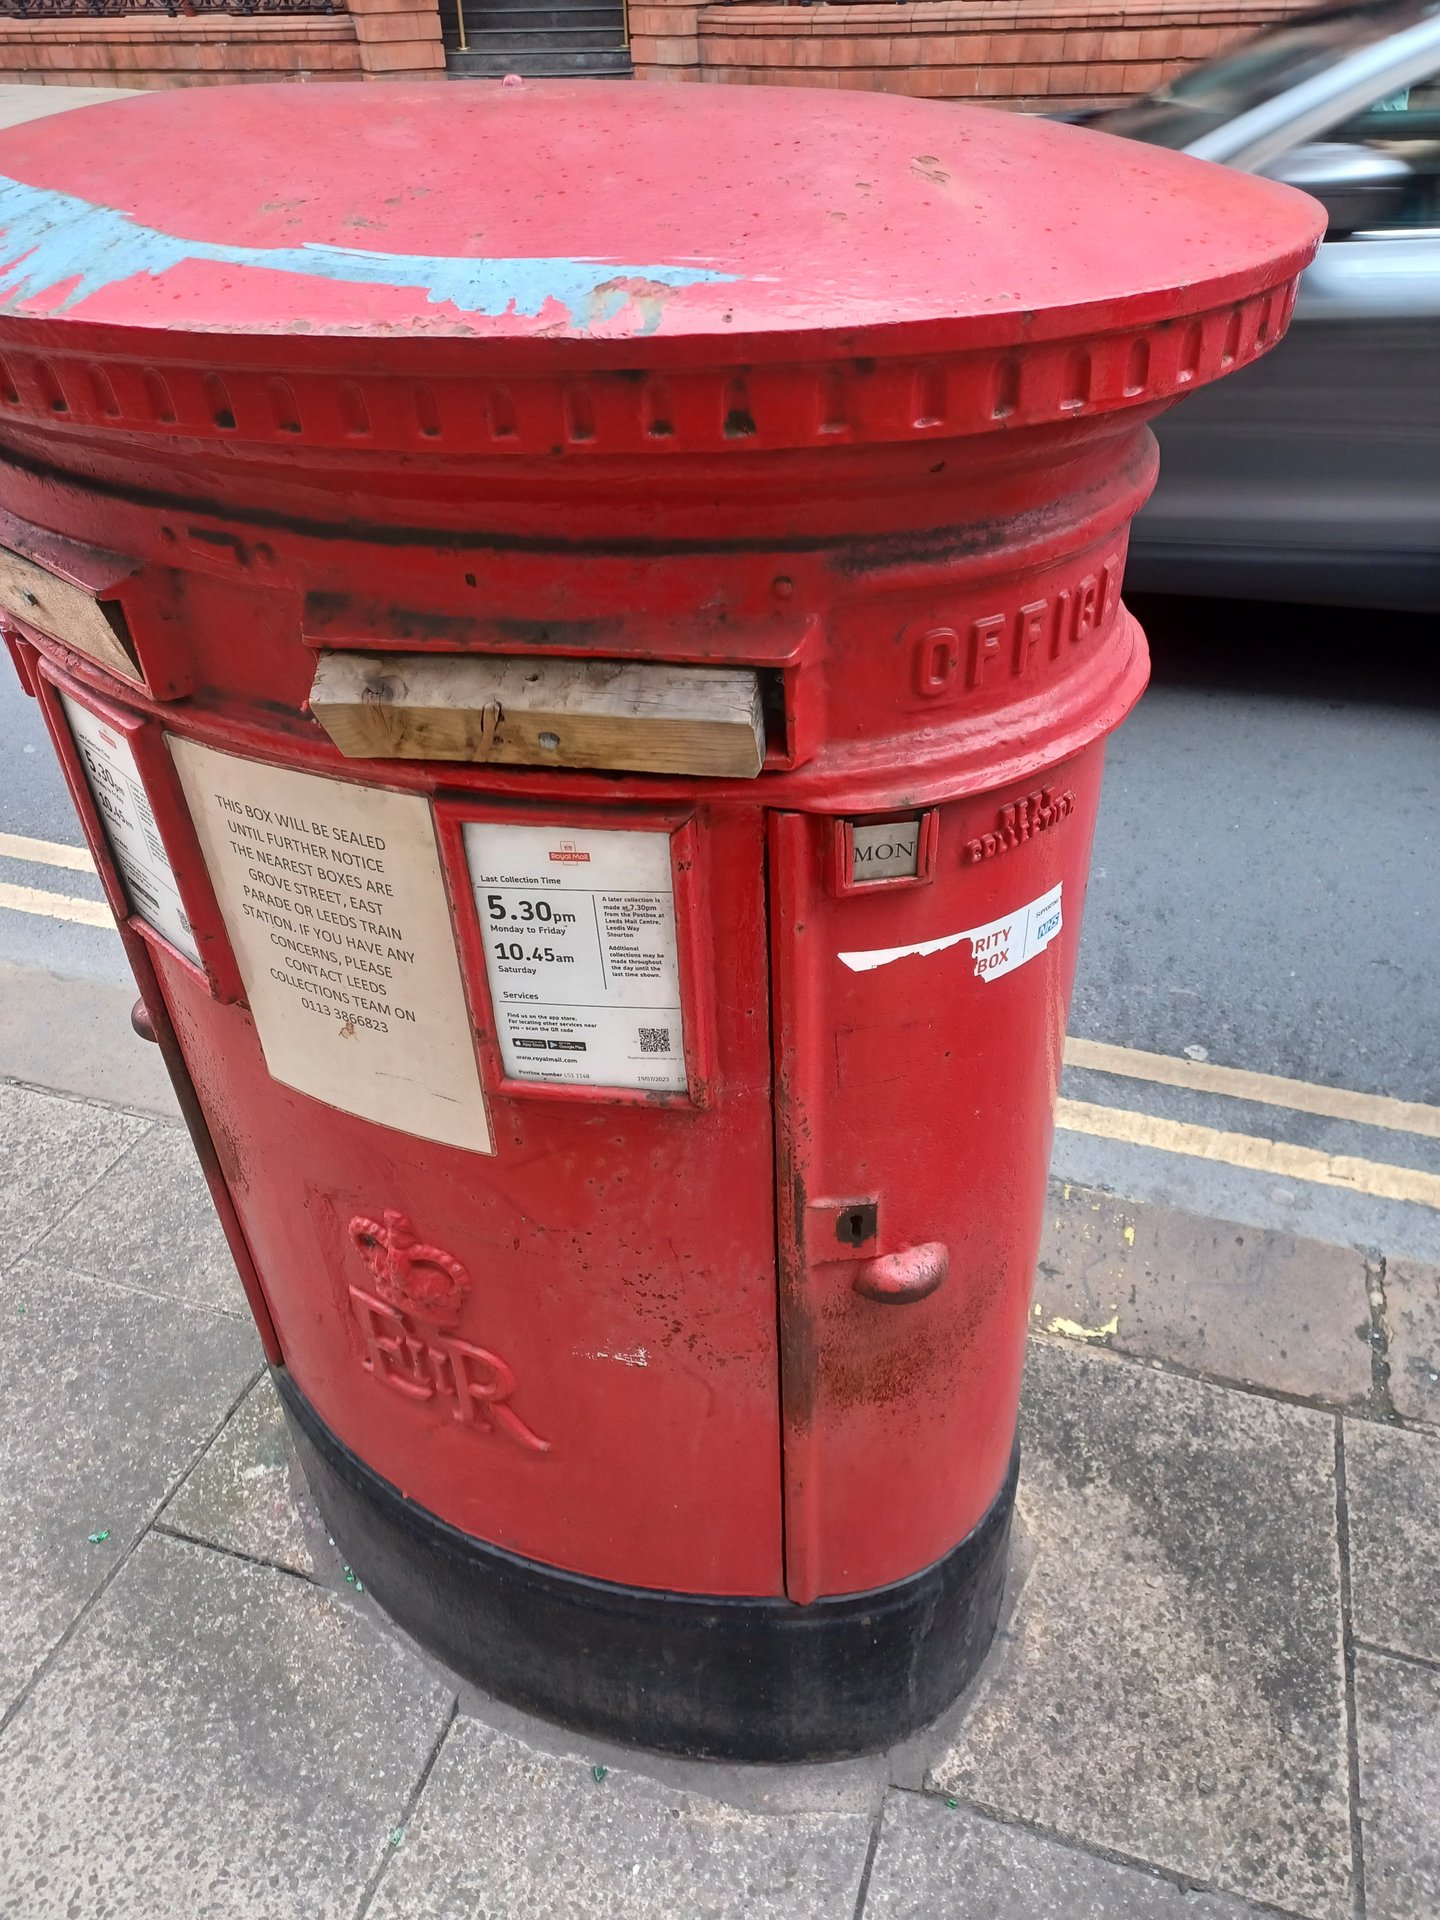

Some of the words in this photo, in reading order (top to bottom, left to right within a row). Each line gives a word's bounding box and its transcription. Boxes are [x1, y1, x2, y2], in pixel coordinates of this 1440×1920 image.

[215, 794, 243, 814] THIS
[245, 805, 273, 824] BOX
[274, 813, 310, 833] WILL
[312, 822, 330, 838] BE
[332, 828, 385, 850] SEALED
[227, 820, 265, 843] UNTIL
[266, 832, 329, 860] FURTHER
[331, 849, 384, 873] NOTICE
[853, 840, 916, 863] MON
[229, 841, 255, 860] THE
[256, 850, 313, 877] NEAREST
[317, 867, 362, 889] BOXES
[366, 880, 394, 897] ARE
[500, 876, 539, 884] Collection
[249, 868, 292, 892] GROVE
[294, 882, 346, 908] STREET,
[349, 896, 383, 915] EAST
[487, 895, 576, 924] 5.30pm
[243, 885, 292, 911] PARADE
[294, 903, 314, 918] OR
[316, 908, 357, 929] LEEDS
[358, 919, 402, 940] TRAIN
[490, 924, 524, 934] Monday
[539, 927, 566, 936] Friday
[1039, 914, 1060, 938] NHS
[242, 904, 297, 933] STATION.
[299, 923, 310, 936] IF
[313, 927, 342, 945] YOU
[346, 936, 384, 957] HAVE
[387, 948, 414, 963] ANY
[270, 933, 342, 966] CONCERNS,
[344, 956, 392, 978] PLEASE
[494, 943, 574, 963] 10.45am
[498, 965, 536, 975] Saturday
[285, 957, 342, 983] CONTACT
[346, 975, 386, 995] LEEDS
[270, 968, 350, 1004] COLLECTIONS
[351, 995, 391, 1016] TEAM
[394, 1008, 416, 1022] ON
[503, 991, 539, 1000] Services
[302, 998, 331, 1016] 0113
[334, 1008, 388, 1035] 3866823
[516, 1055, 578, 1064] www.royalmail.com
